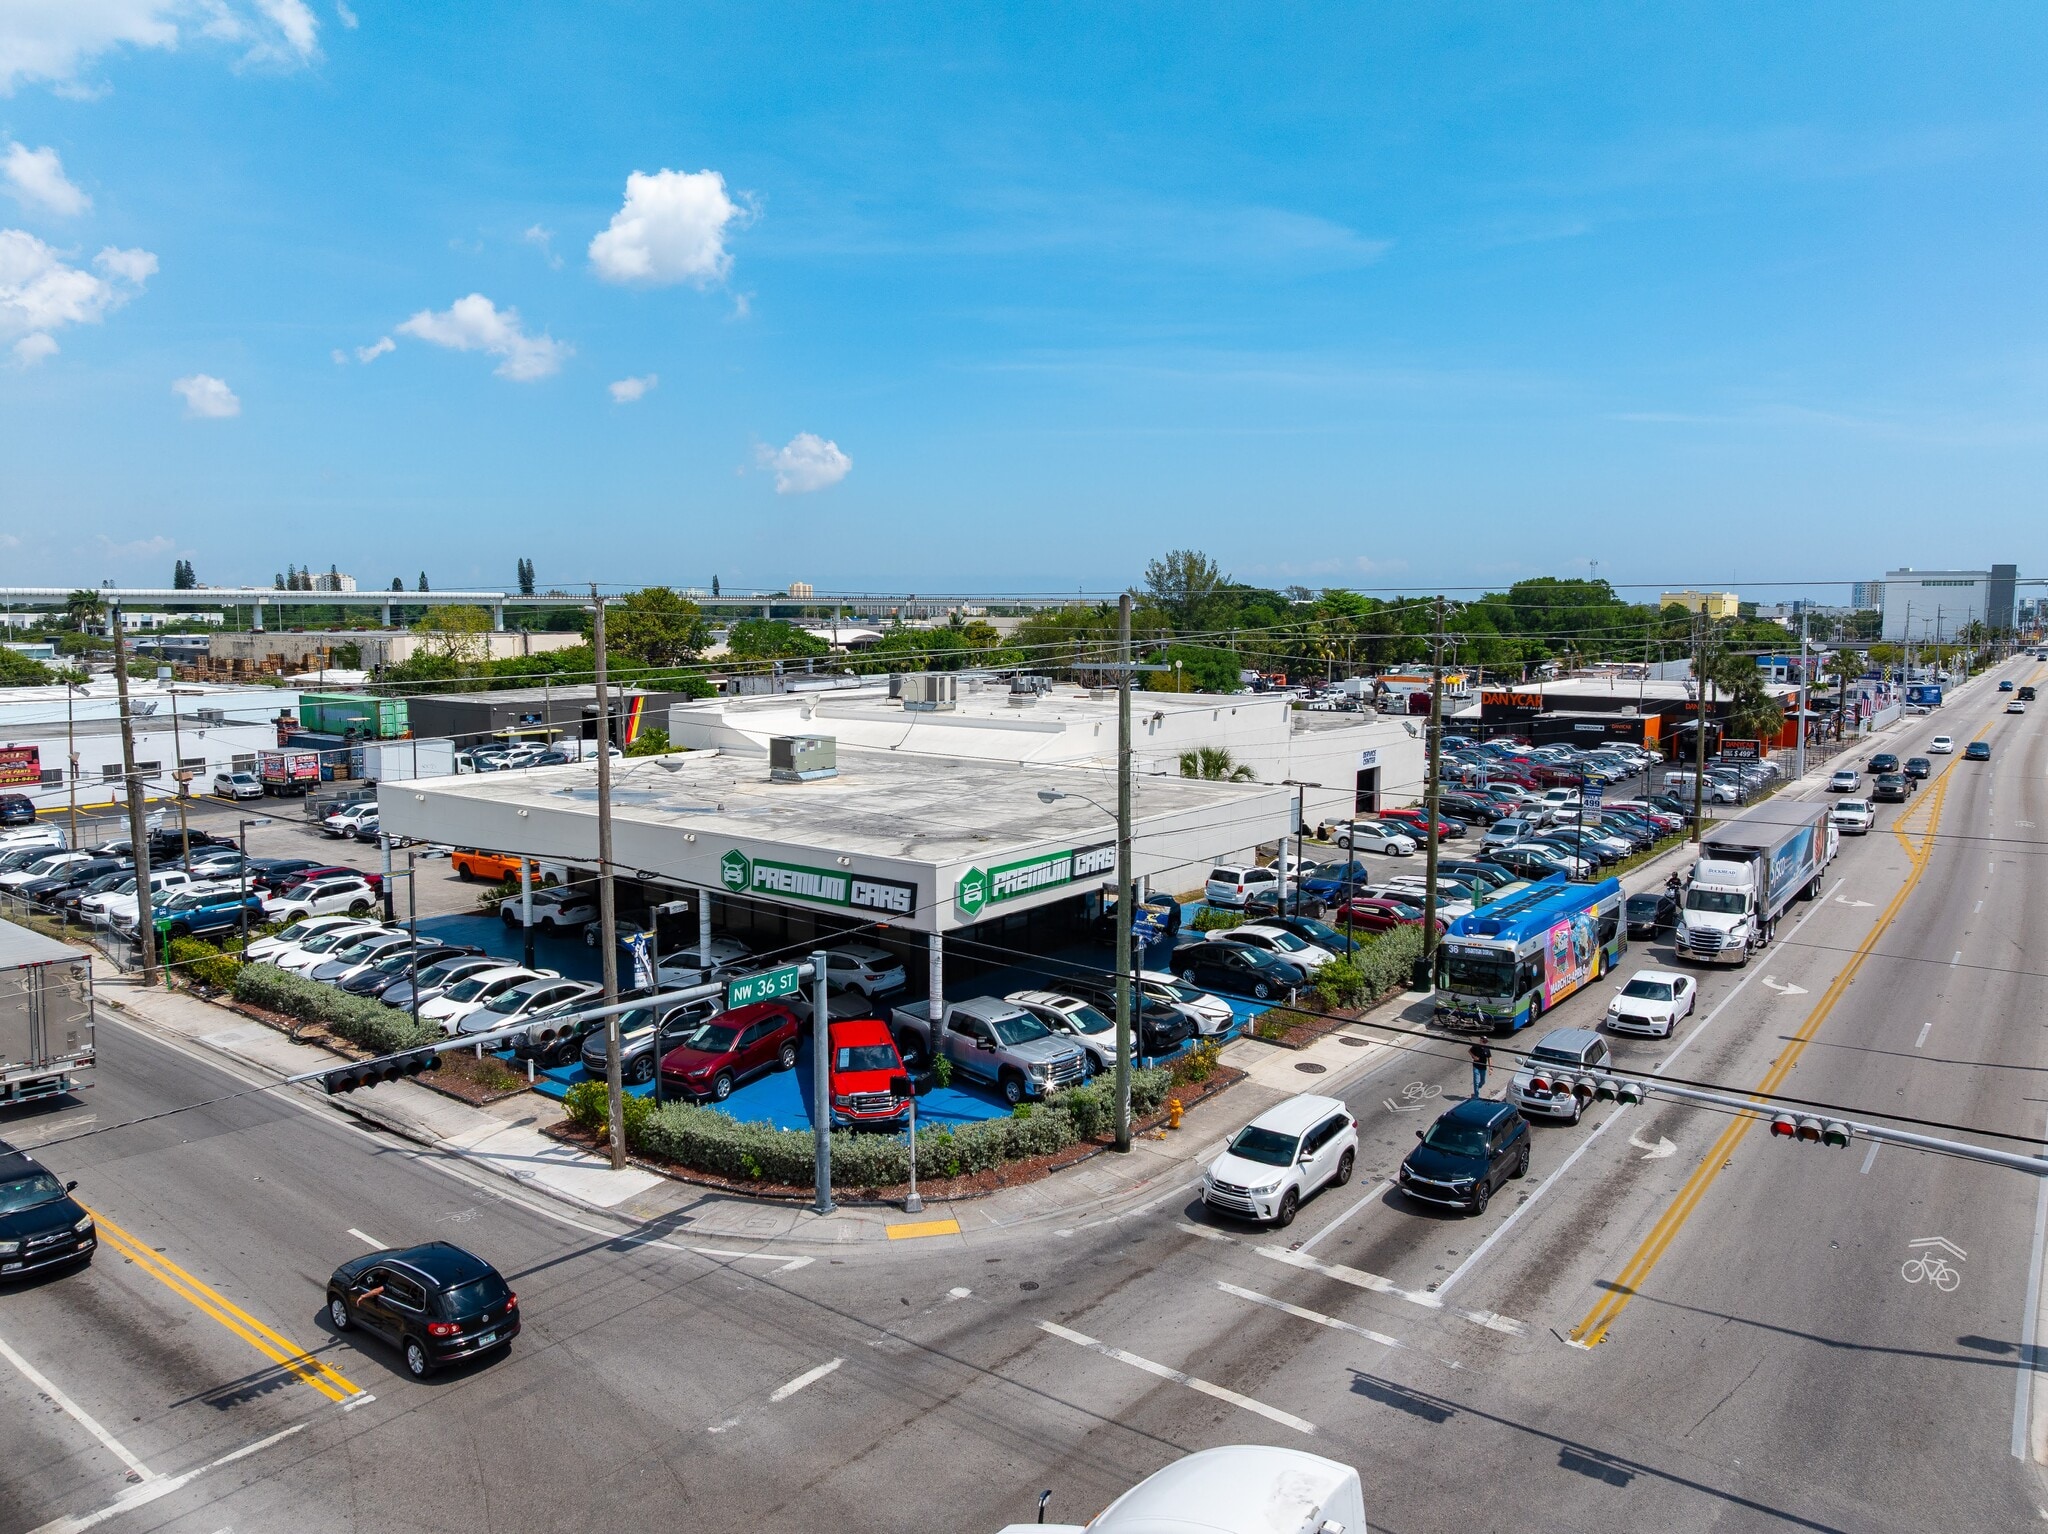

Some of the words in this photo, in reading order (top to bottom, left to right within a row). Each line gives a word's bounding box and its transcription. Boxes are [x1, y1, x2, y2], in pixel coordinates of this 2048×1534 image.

[1482, 692, 1544, 707] DANYCAR
[1584, 799, 1600, 807] 499
[993, 854, 1072, 897] PREMIUM
[1073, 846, 1116, 876] CARS
[753, 865, 847, 901] PREMIUM
[851, 880, 912, 912] CARS
[1448, 945, 1459, 954] 36
[734, 984, 752, 1002] NW
[757, 978, 775, 997] 36
[780, 973, 794, 989] ST
